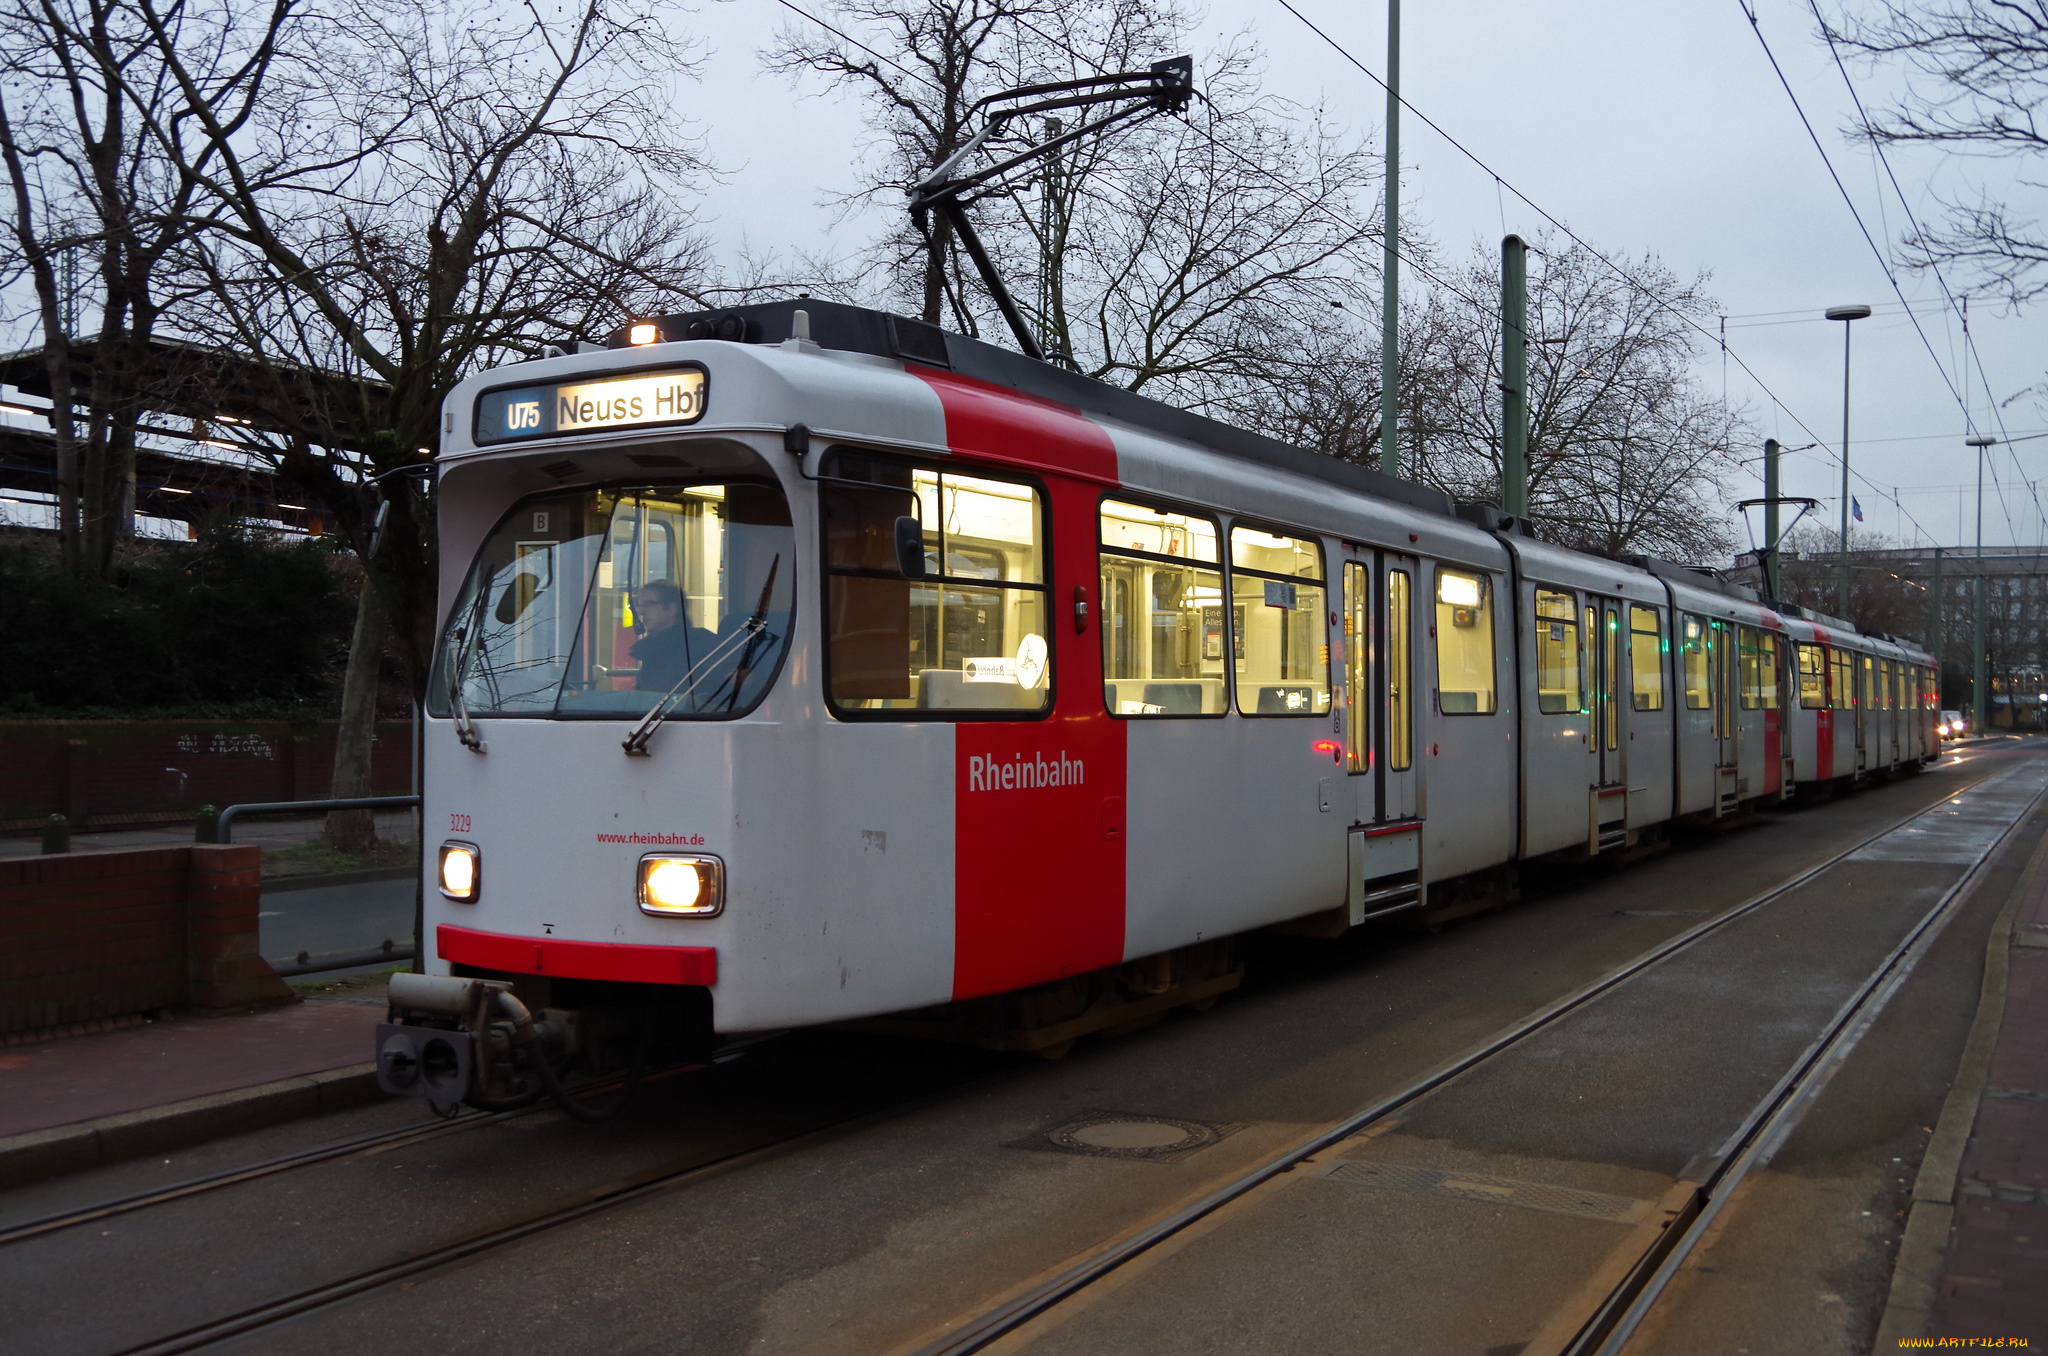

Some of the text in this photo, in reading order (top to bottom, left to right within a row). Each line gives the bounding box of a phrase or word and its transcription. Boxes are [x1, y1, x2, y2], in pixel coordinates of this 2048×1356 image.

[560, 382, 704, 424] Neuss Hbf
[508, 401, 540, 430] U75
[536, 512, 546, 529] B
[1205, 618, 1222, 626] Alles
[969, 750, 1084, 792] Rheinbahn
[450, 814, 471, 833] 3229
[597, 831, 705, 846] www.rheinbahn.de
